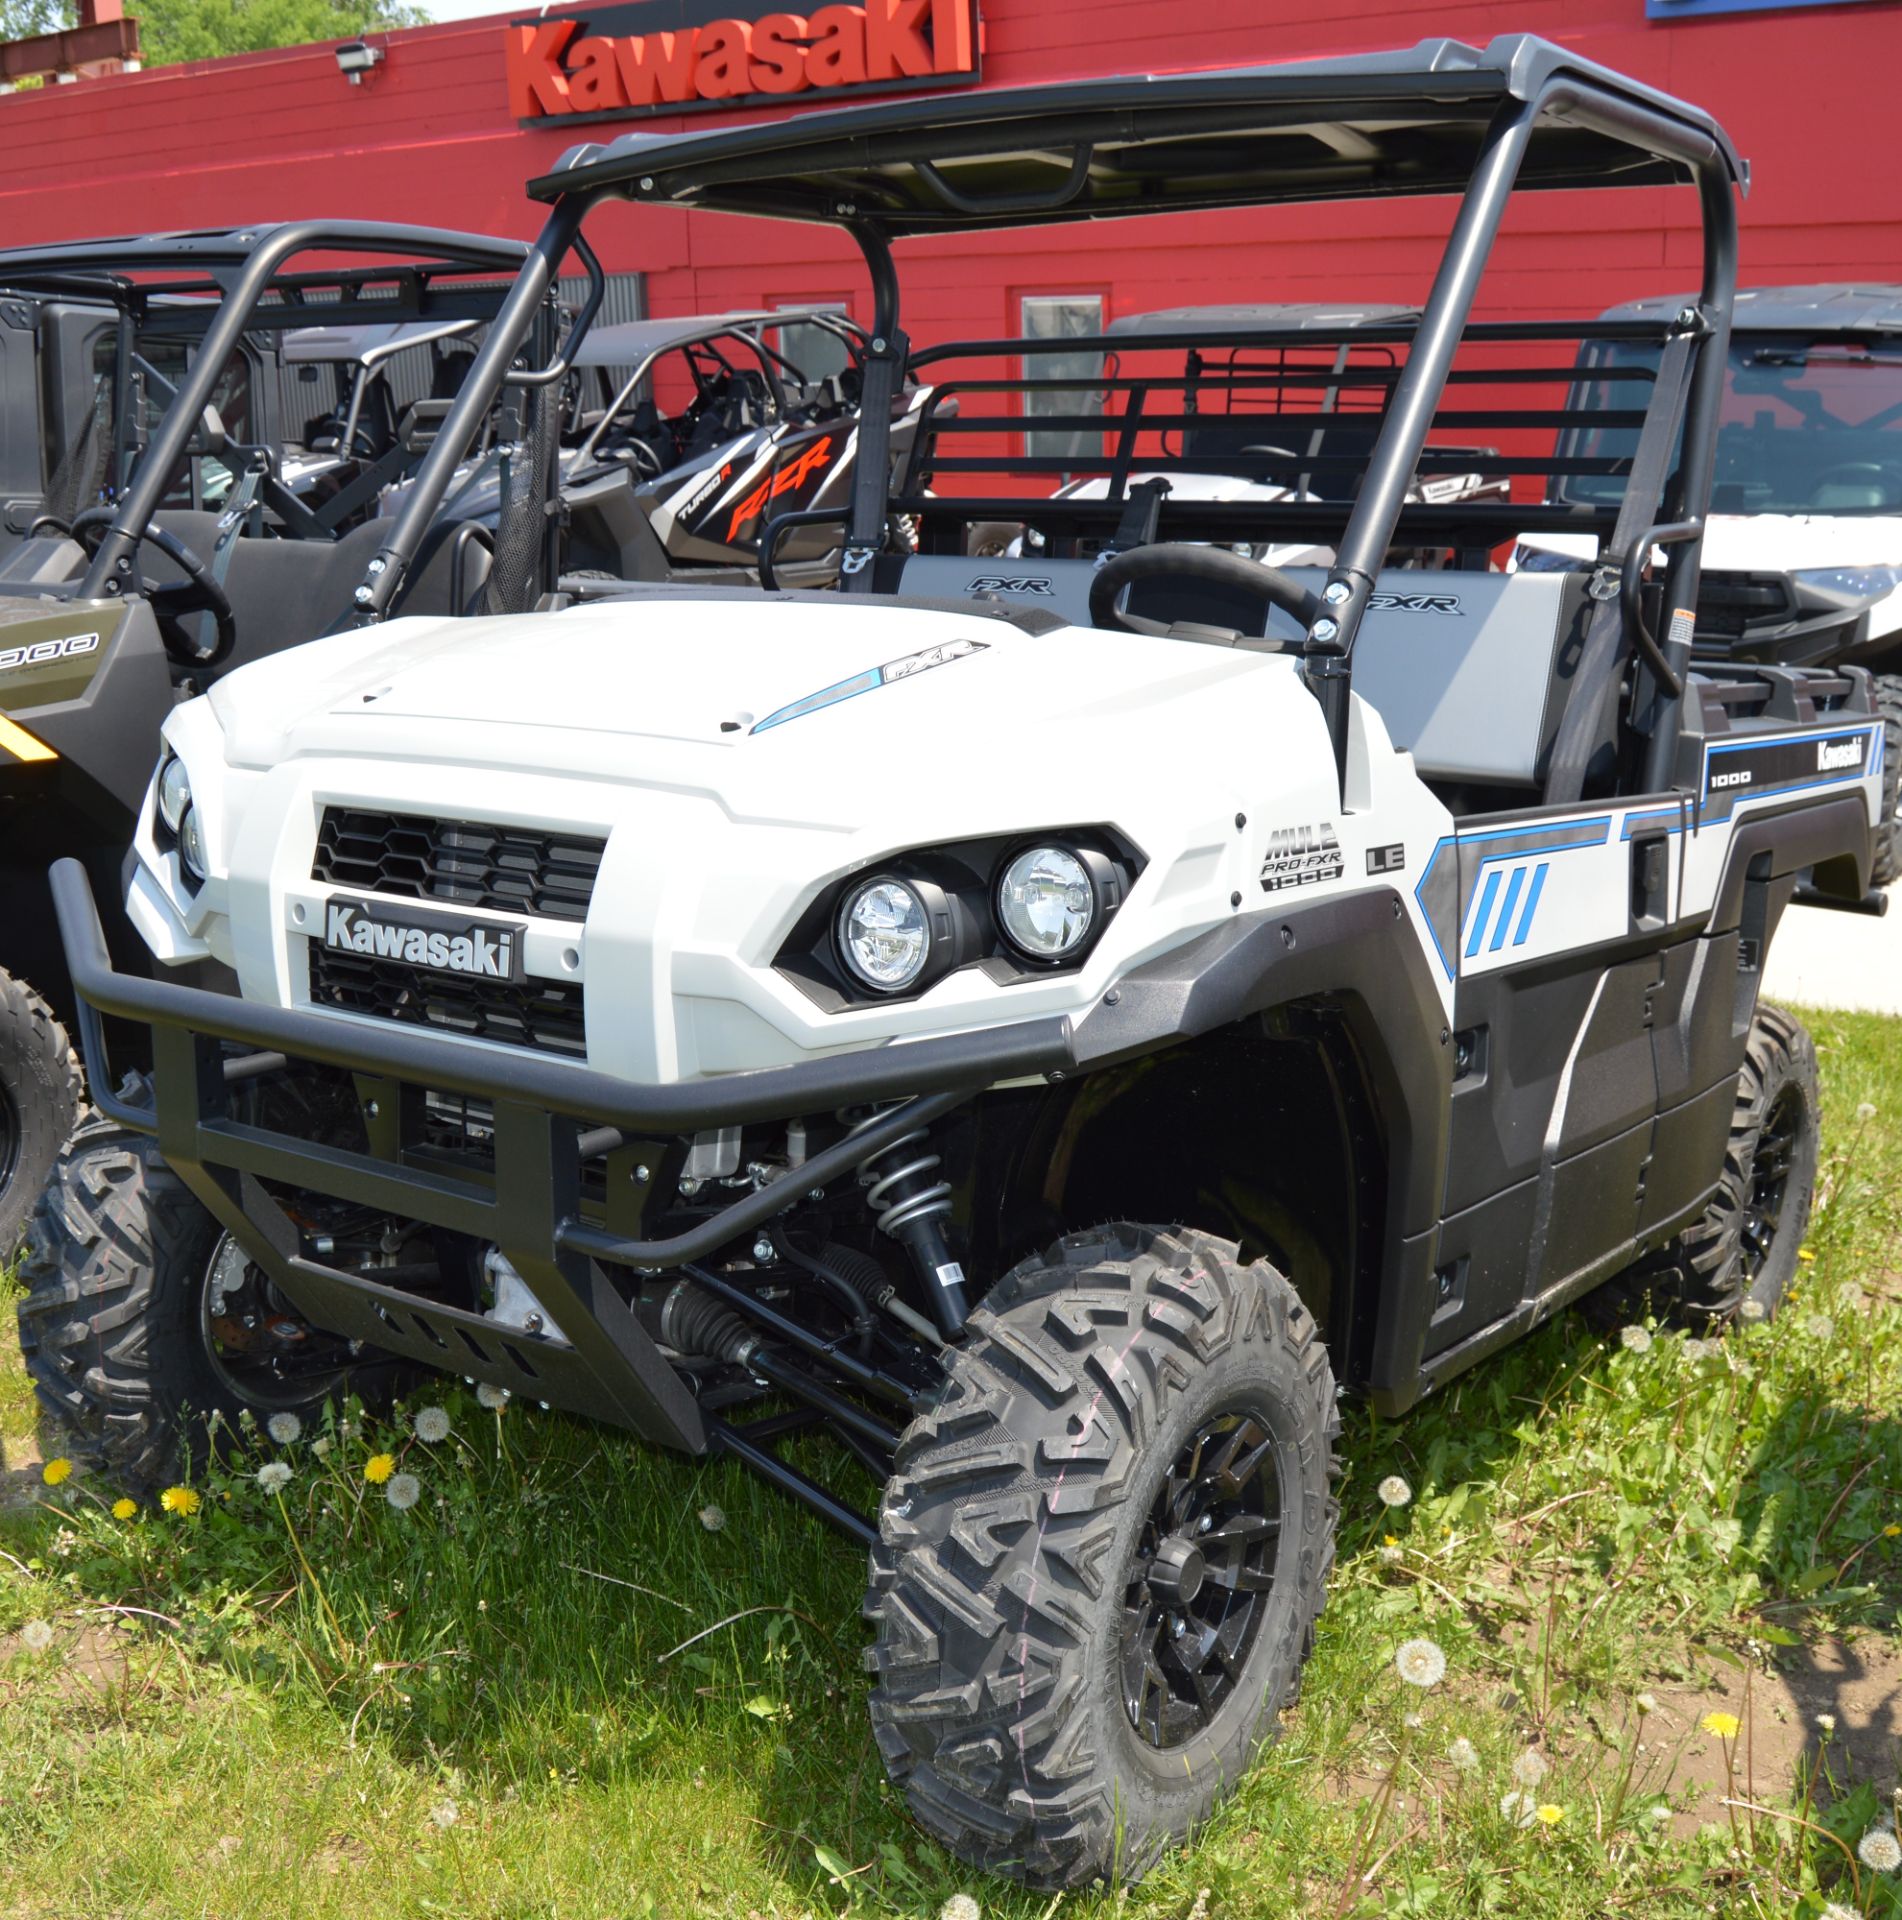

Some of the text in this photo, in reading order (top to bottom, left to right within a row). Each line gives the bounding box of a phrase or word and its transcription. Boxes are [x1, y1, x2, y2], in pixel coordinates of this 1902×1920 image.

[506, 0, 972, 118] Kawasaki
[726, 436, 832, 544] RZR
[964, 575, 1057, 596] FXR
[883, 639, 989, 684] FXR
[1817, 736, 1862, 771] Kawasaki
[1711, 771, 1752, 788] 1000
[1265, 822, 1340, 861] MULE
[1366, 844, 1405, 874] LE
[1259, 851, 1343, 877] PRO-FXR
[1266, 866, 1340, 891] 1000
[327, 904, 511, 978] Kawasaki
